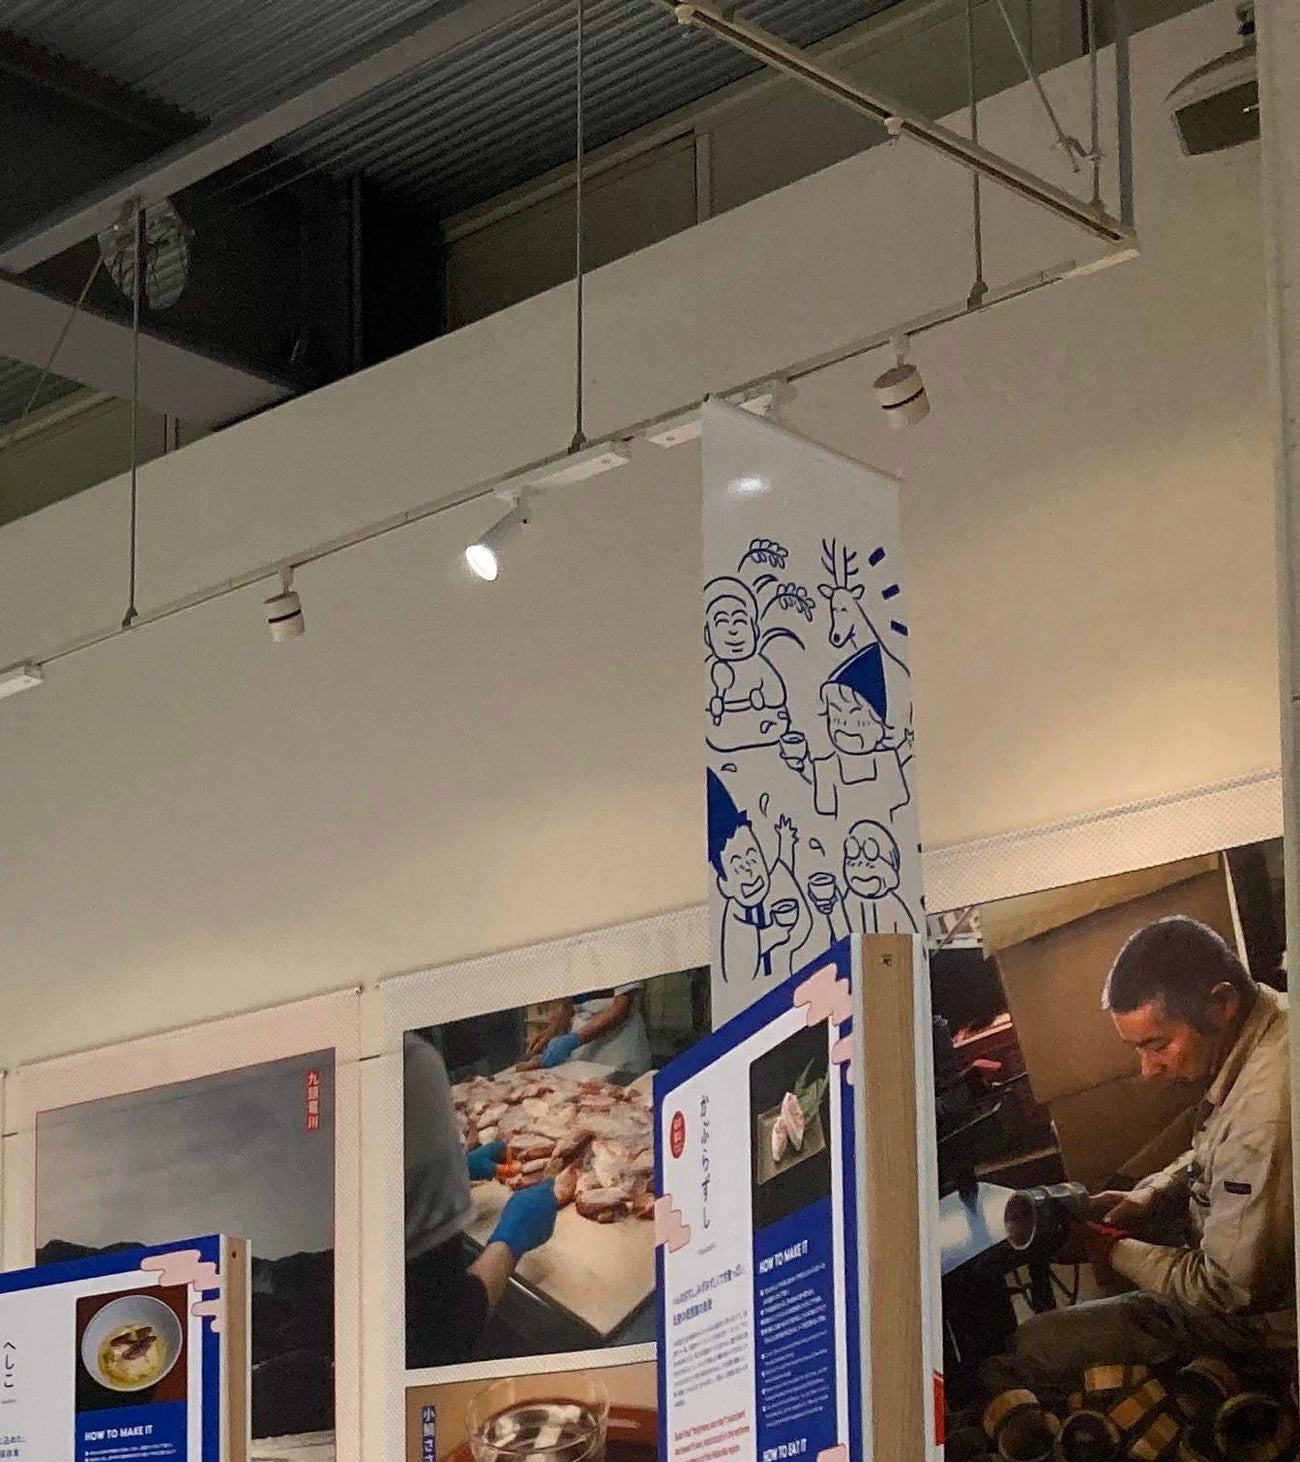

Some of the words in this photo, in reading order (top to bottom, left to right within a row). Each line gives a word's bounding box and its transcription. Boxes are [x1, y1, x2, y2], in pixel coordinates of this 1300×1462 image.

[3, 1341, 17, 1388] へしこ
[84, 1431, 105, 1441] HOW
[106, 1428, 119, 1438] TO
[120, 1426, 144, 1437] MAKE
[144, 1424, 153, 1434] IT
